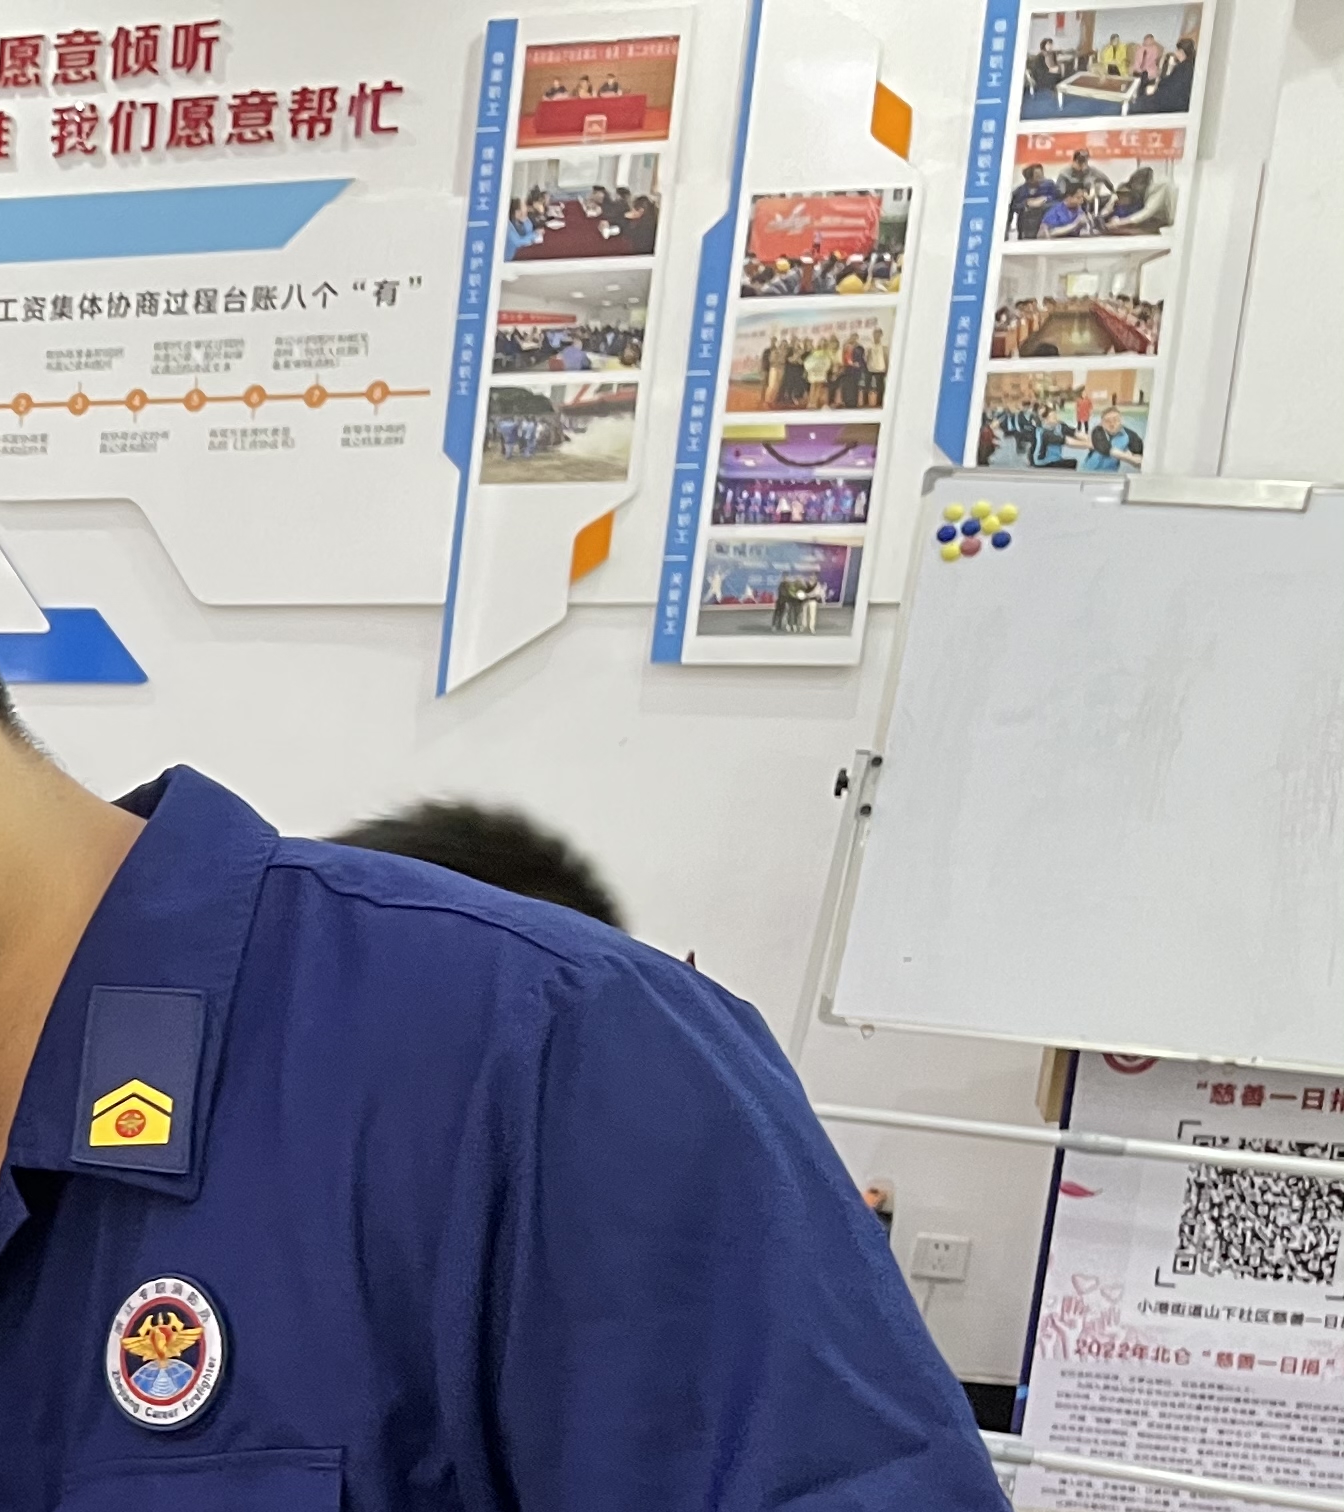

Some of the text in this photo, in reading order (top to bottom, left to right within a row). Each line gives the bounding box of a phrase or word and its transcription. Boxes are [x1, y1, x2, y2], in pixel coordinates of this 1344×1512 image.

[51, 80, 404, 158] 我们愿意帮忙
[1138, 1300, 1344, 1329] 小港街道山下社区慈善一日
